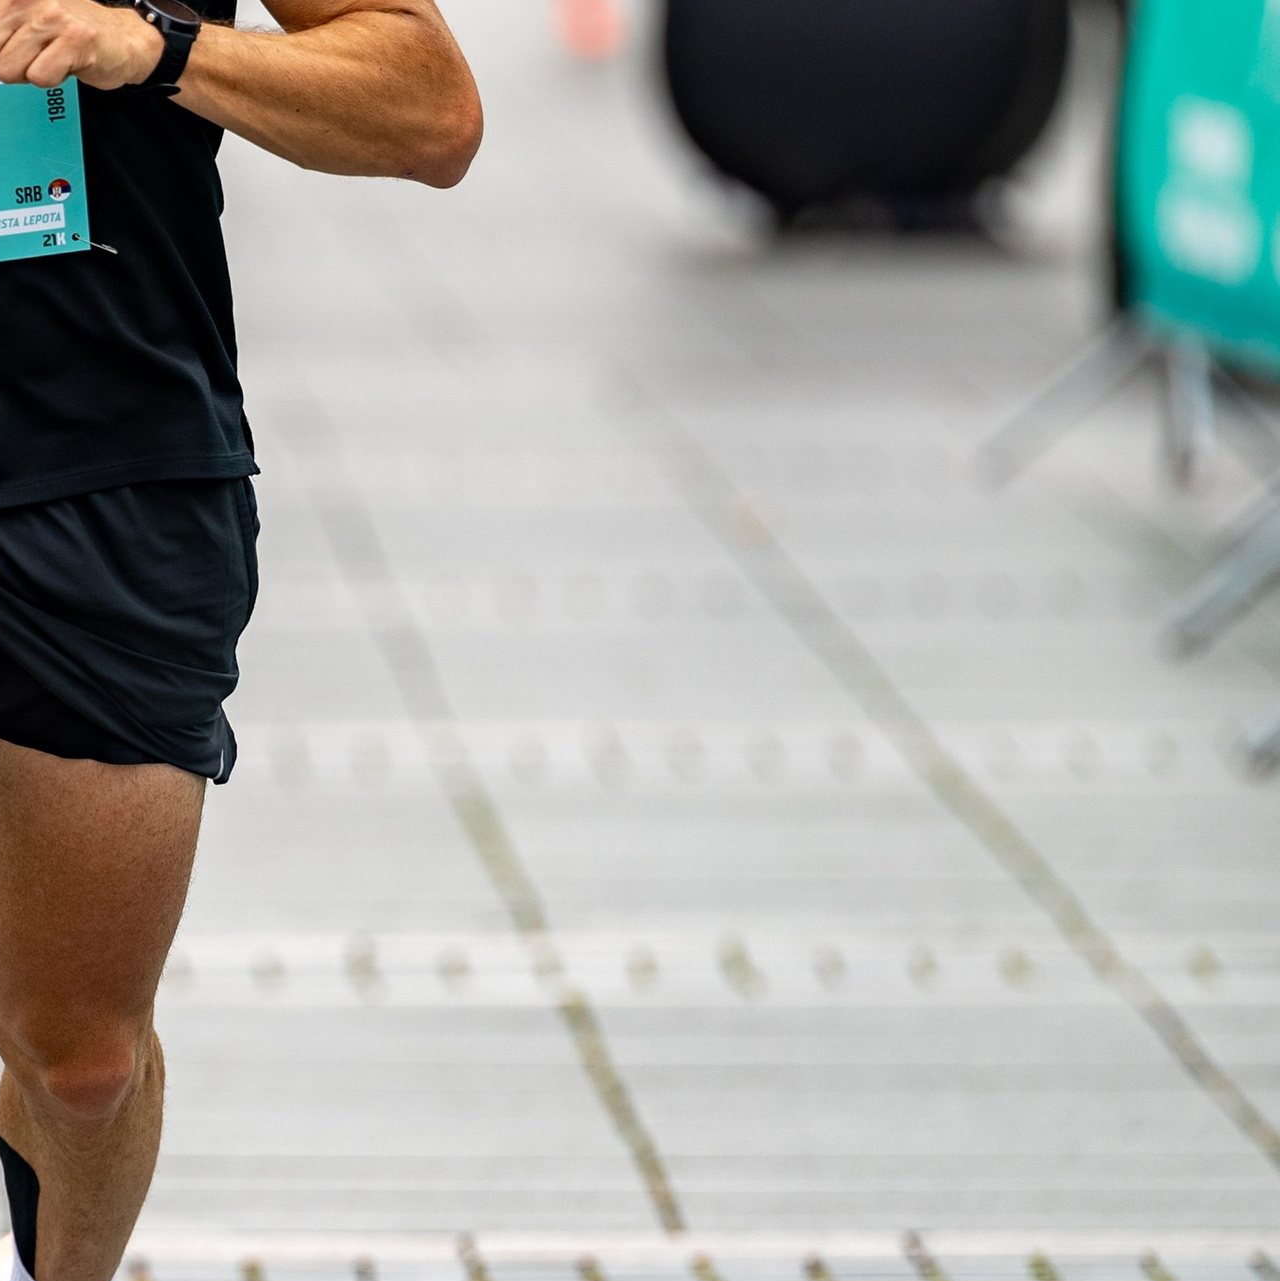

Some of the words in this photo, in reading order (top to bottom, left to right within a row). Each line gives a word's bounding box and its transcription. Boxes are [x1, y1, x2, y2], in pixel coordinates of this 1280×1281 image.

[46, 87, 66, 123] 1986
[15, 185, 43, 204] SRB
[23, 212, 61, 226] LEPOTA
[42, 232, 67, 247] 21K
